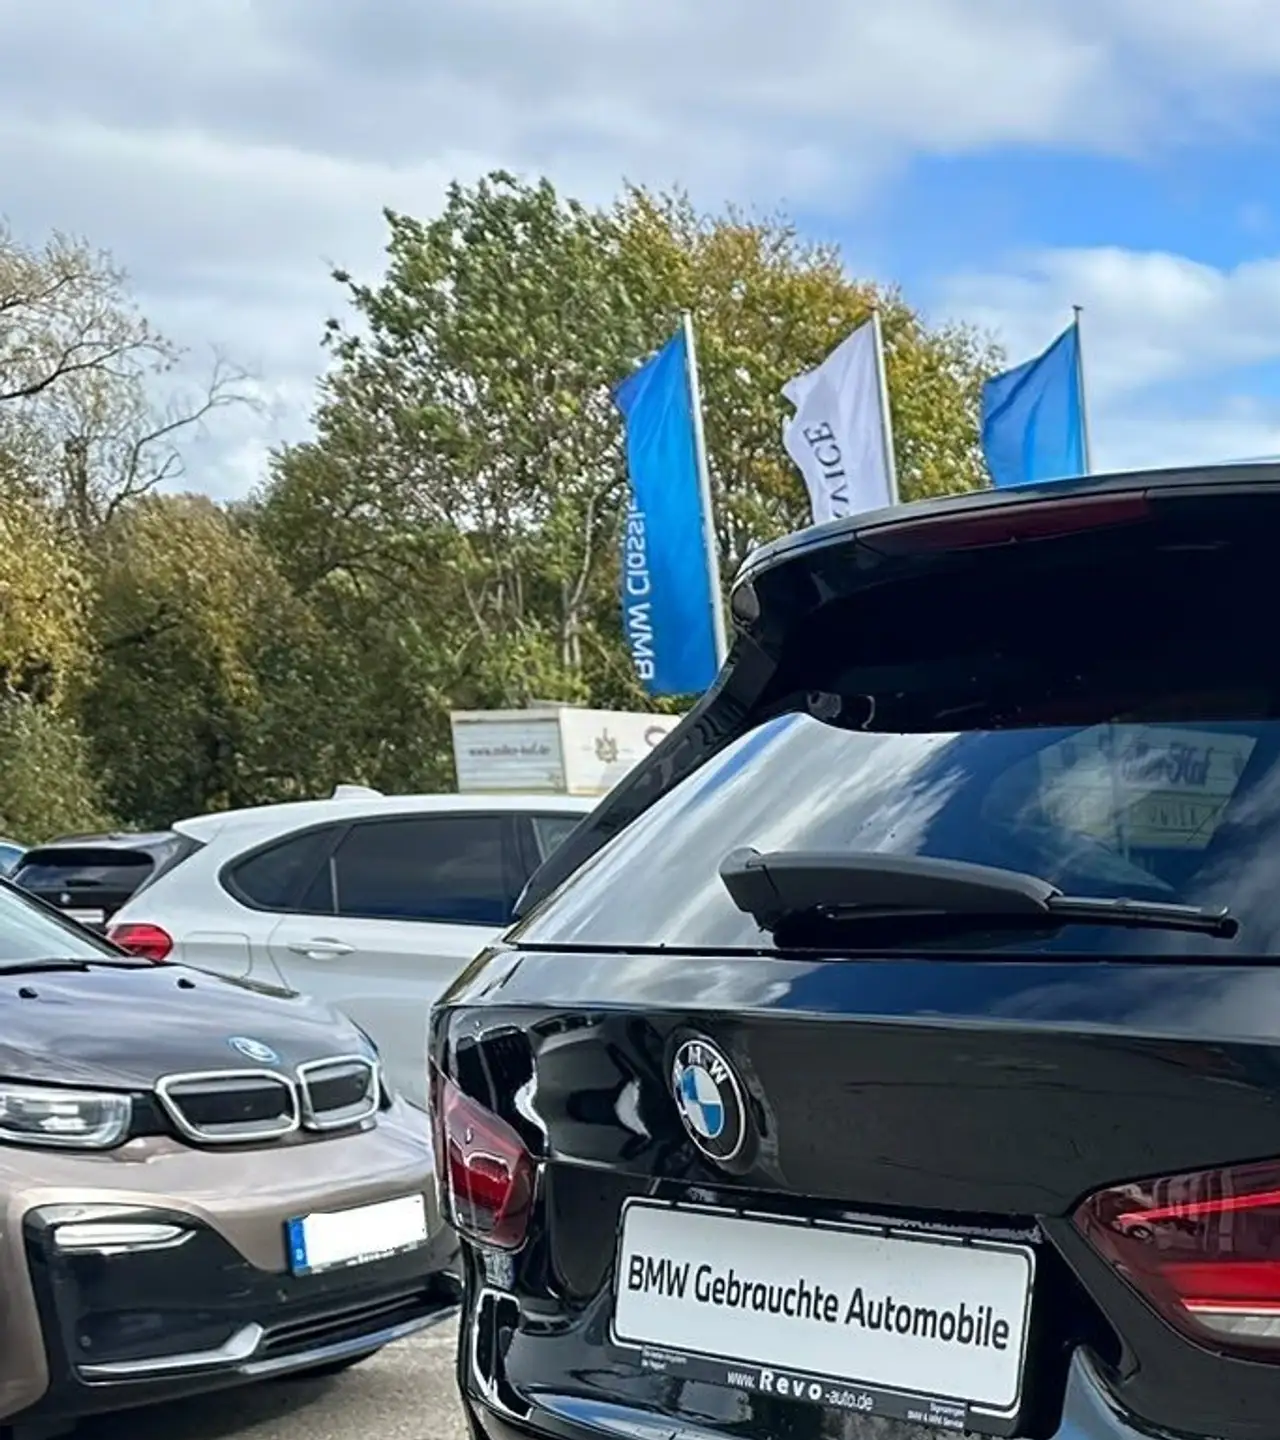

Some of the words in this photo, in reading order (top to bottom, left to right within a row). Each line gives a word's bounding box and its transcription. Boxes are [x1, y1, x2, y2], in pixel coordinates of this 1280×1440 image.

[628, 1254, 690, 1298] BMW
[695, 1264, 839, 1323] Gebrauchte
[844, 1287, 1010, 1350] Automobile
